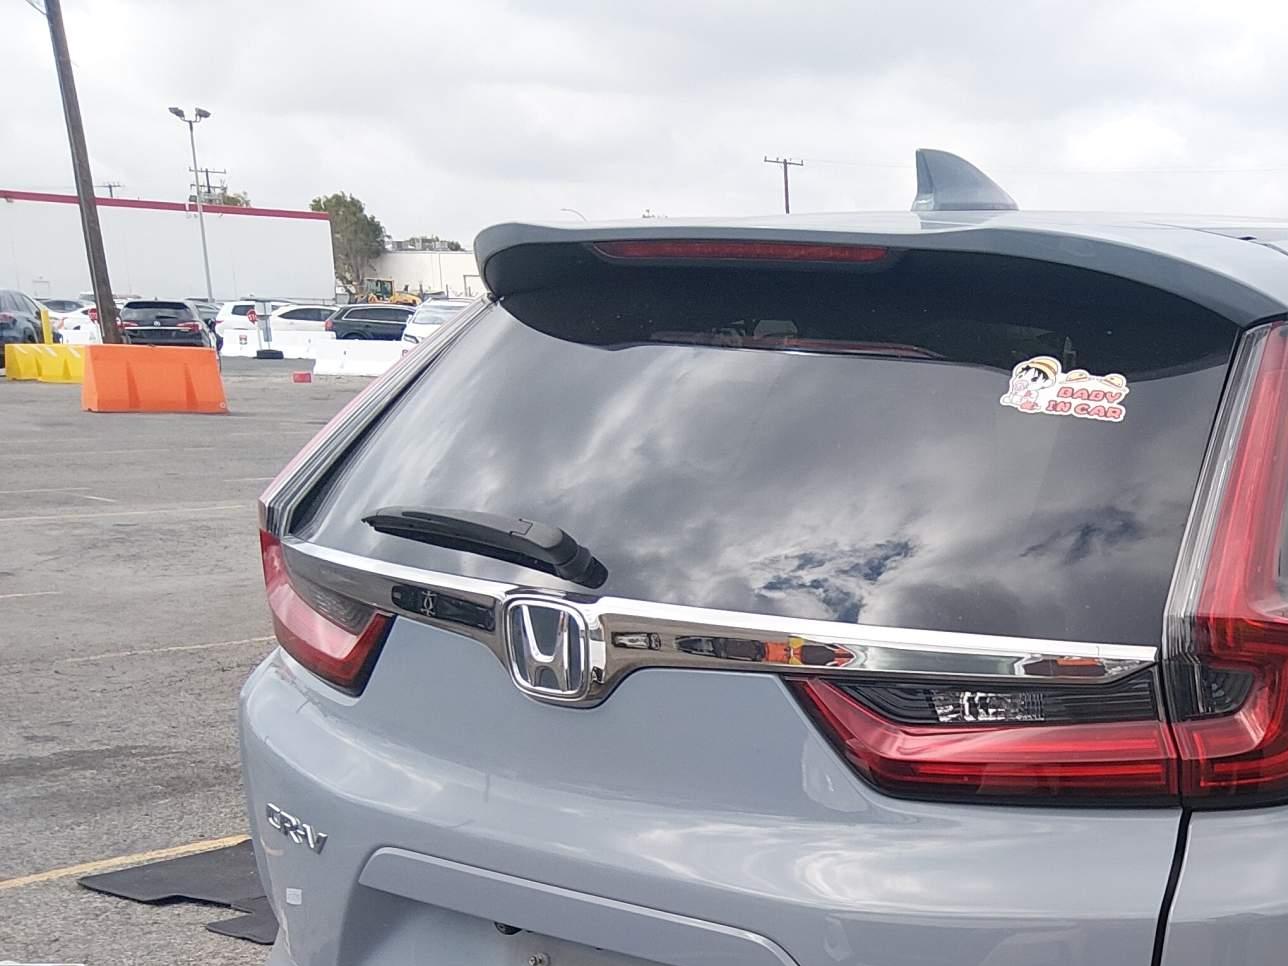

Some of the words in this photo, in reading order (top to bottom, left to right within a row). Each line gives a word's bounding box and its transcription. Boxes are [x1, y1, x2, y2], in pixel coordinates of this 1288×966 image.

[1057, 386, 1122, 403] BABY
[1046, 400, 1072, 412] IN
[1074, 403, 1122, 419] CAR
